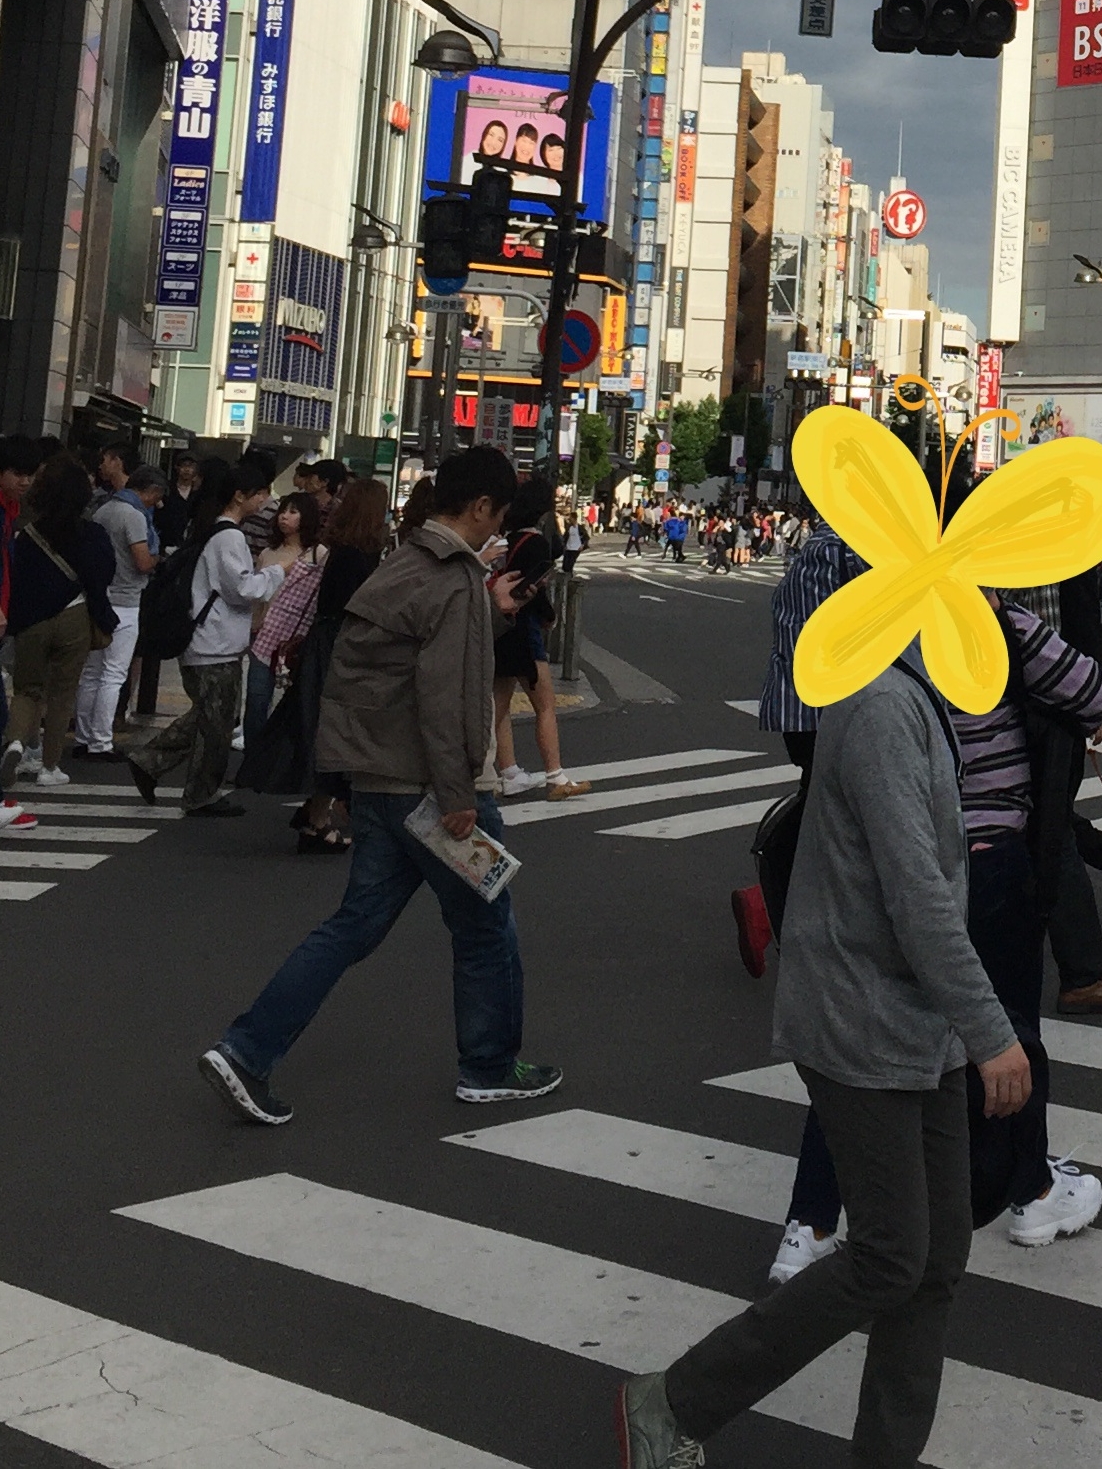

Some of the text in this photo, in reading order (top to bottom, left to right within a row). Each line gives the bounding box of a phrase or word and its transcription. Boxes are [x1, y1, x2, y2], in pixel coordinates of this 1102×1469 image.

[256, 63, 279, 144] みずほ銀行
[173, 178, 205, 188] Ladies
[999, 145, 1020, 283] BIC CAMERA
[167, 262, 195, 271] スーツ
